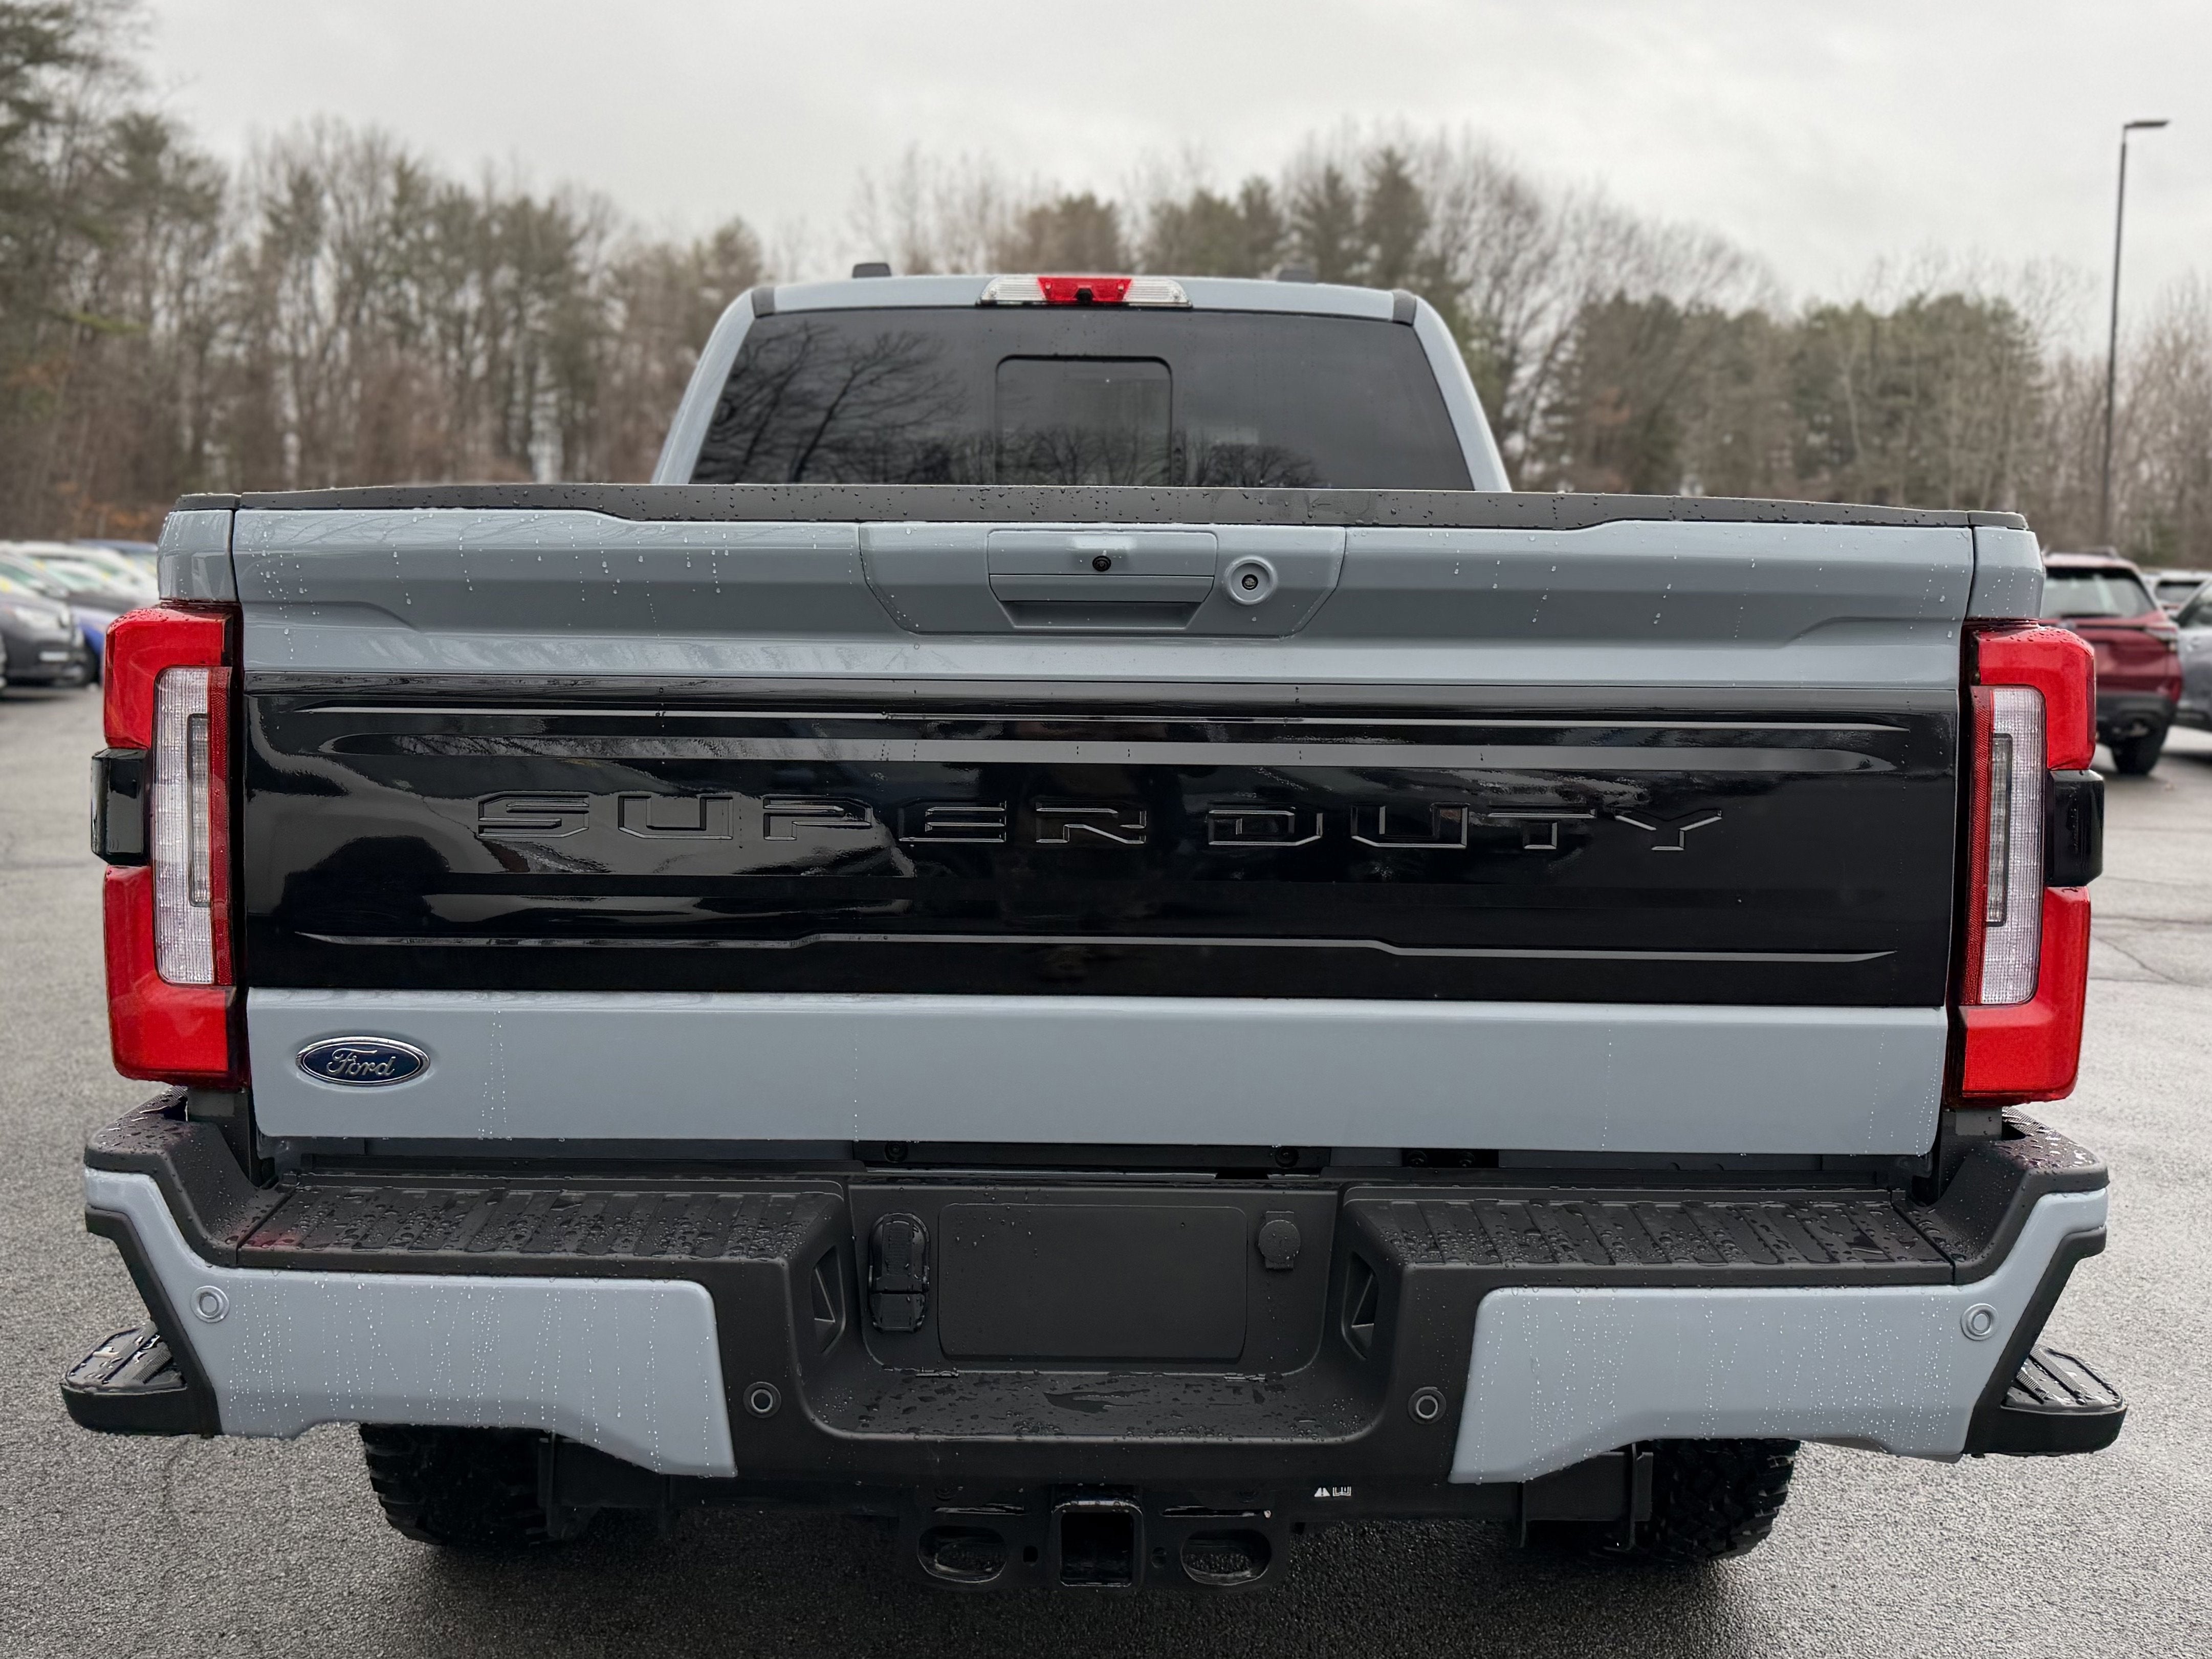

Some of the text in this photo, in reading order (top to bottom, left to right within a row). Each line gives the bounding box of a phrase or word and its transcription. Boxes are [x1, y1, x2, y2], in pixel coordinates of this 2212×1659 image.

[477, 791, 1723, 852] SUPER DUTY
[326, 1048, 396, 1076] Ford
